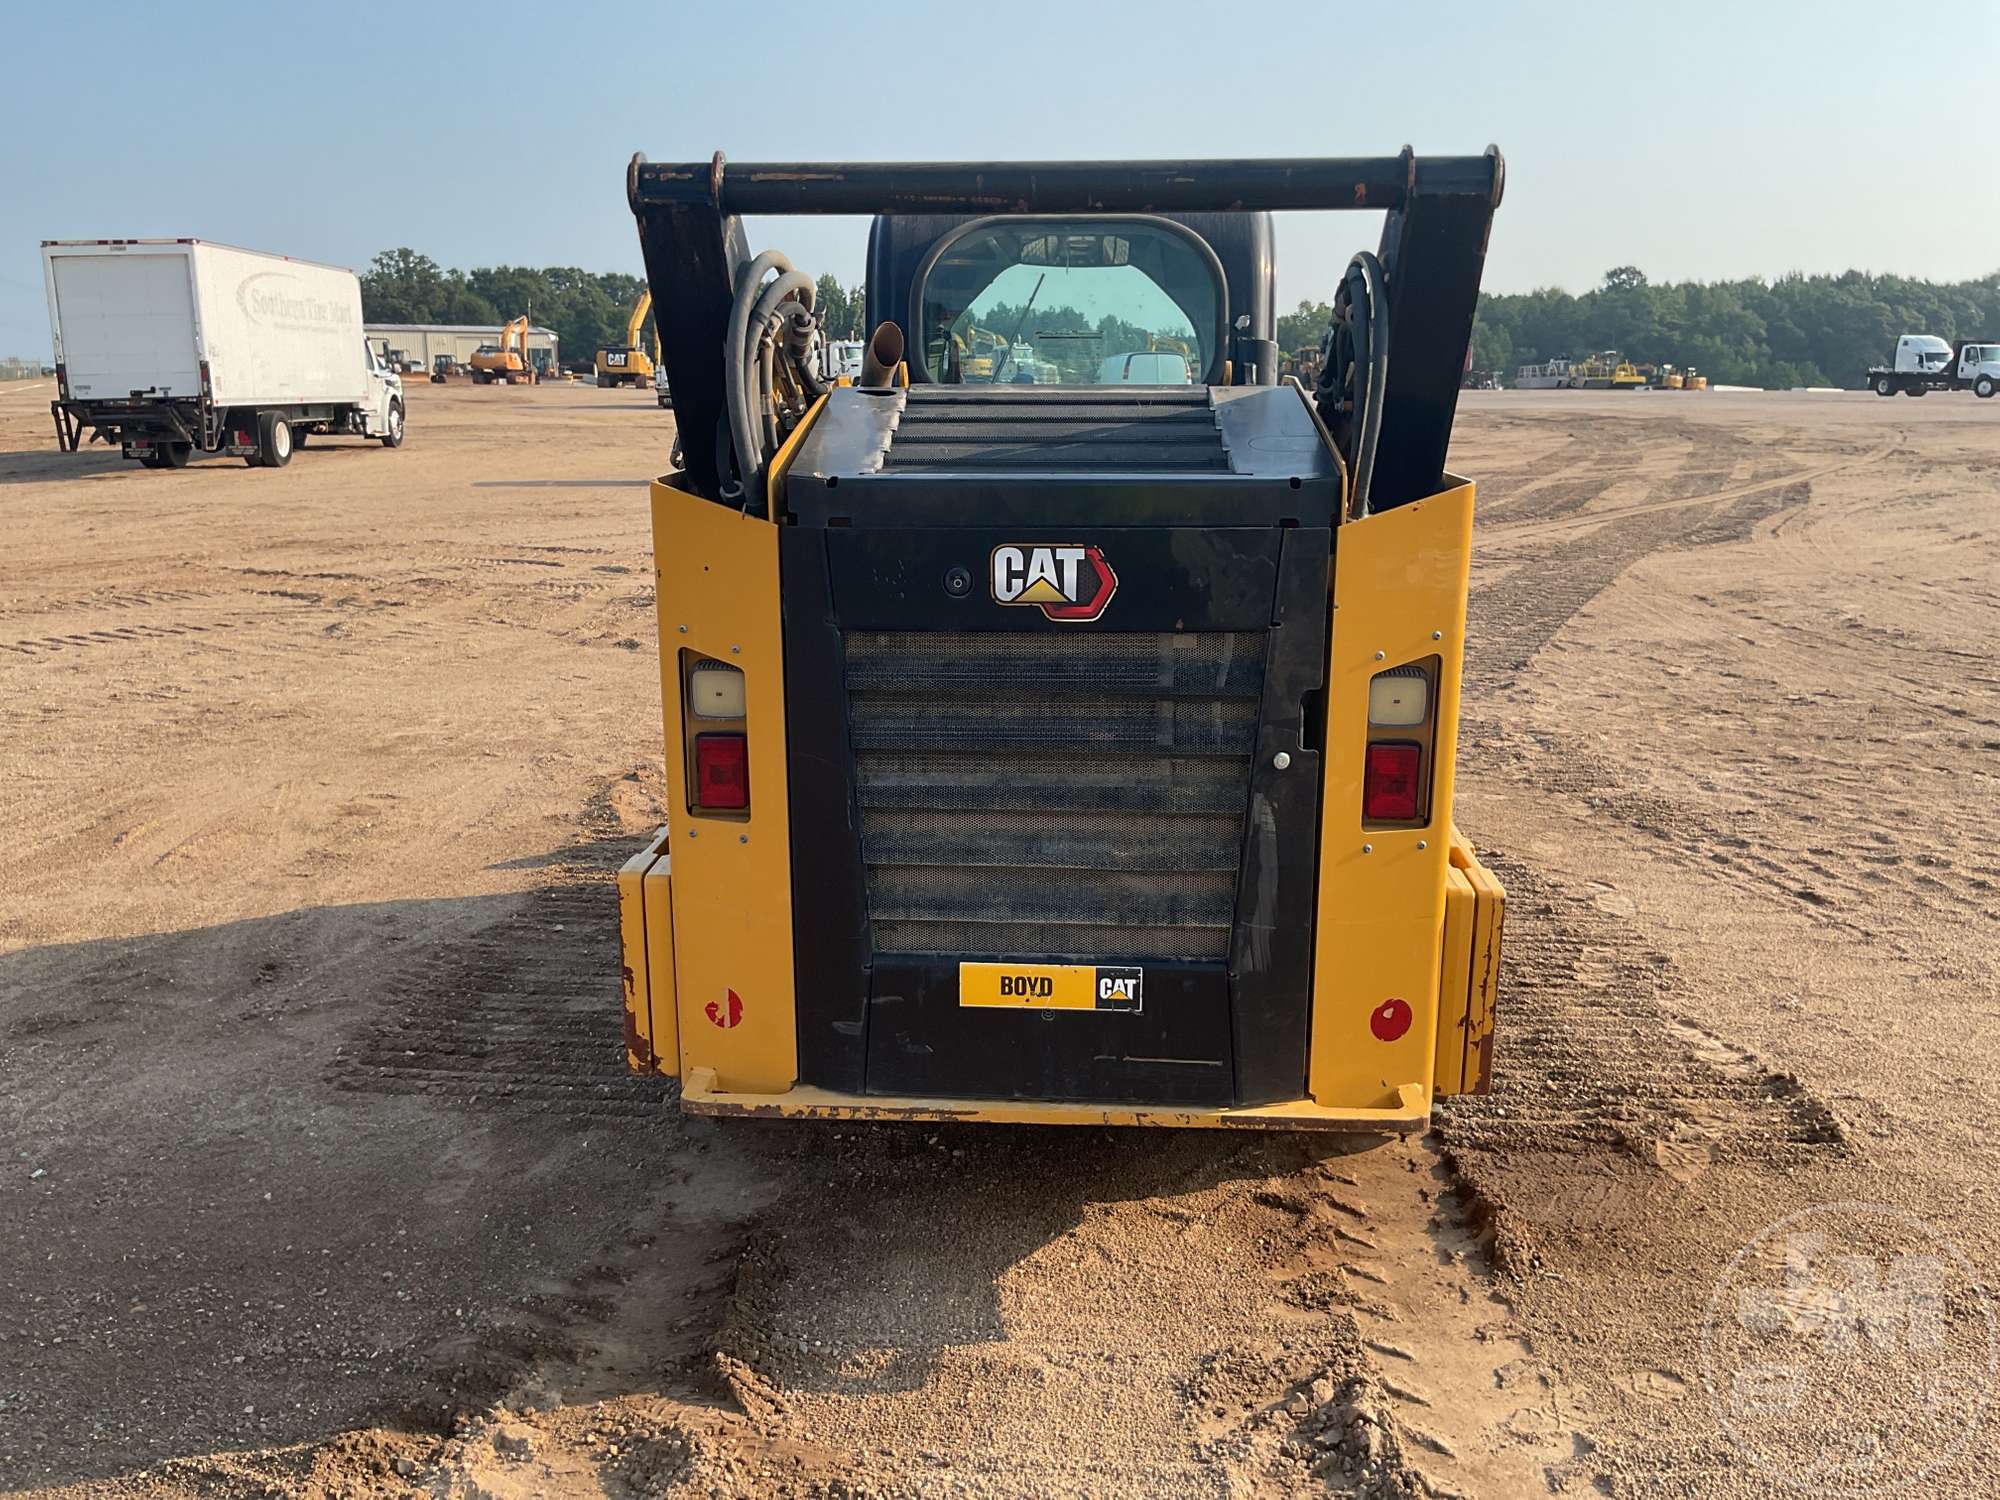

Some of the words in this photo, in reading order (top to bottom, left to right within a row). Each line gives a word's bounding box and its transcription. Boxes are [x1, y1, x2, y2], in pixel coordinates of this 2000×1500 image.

[608, 353, 626, 366] CAT
[994, 546, 1085, 602] CAT
[1000, 975, 1053, 997] BOYD
[1099, 978, 1137, 1000] CAT
